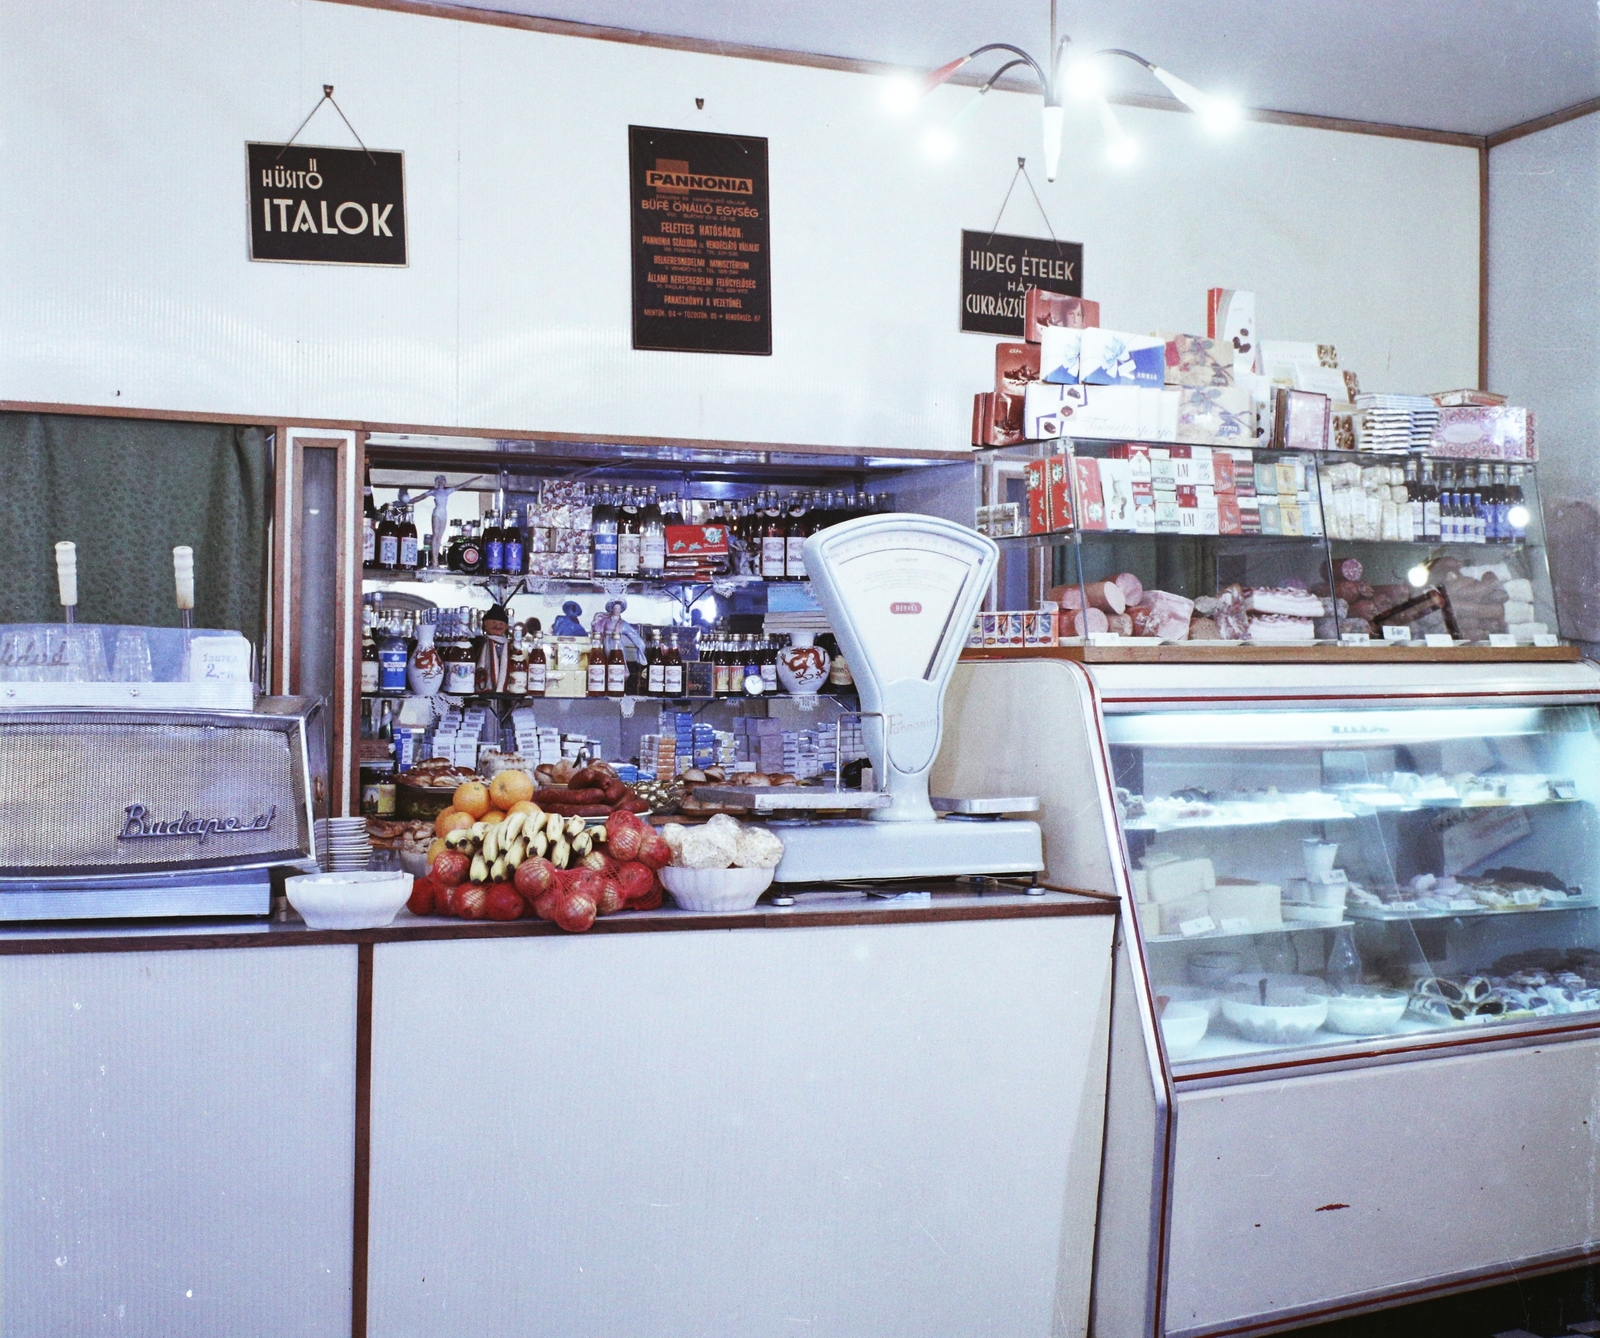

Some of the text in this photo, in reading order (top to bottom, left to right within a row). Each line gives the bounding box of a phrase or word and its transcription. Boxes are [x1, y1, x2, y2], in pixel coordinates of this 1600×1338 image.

[262, 158, 323, 190] HÜSITŐ
[649, 173, 750, 192] PANNONIA
[642, 198, 759, 218] BÜFÉ ÖNÁLLÓ EGYSÉG
[263, 198, 394, 237] ITALOK
[661, 221, 694, 235] FELETTES
[642, 235, 670, 246] PANNONIA
[672, 236, 697, 248] SZÁLLODA
[738, 241, 760, 252] VÁLLALAT
[654, 254, 750, 270] BELKERESKEDELMI MINISZTÉRIUM
[970, 249, 1075, 281] HIDEG ÉTELEK
[647, 272, 668, 283] ÁLLAMI
[670, 274, 714, 287] KERESKEDELMI
[664, 293, 742, 309] PANASZKÖNYV A VEZETŐNÉL
[459, 543, 479, 551] UNICUM
[895, 604, 918, 612] BERKEL
[117, 802, 277, 845] Budapest
